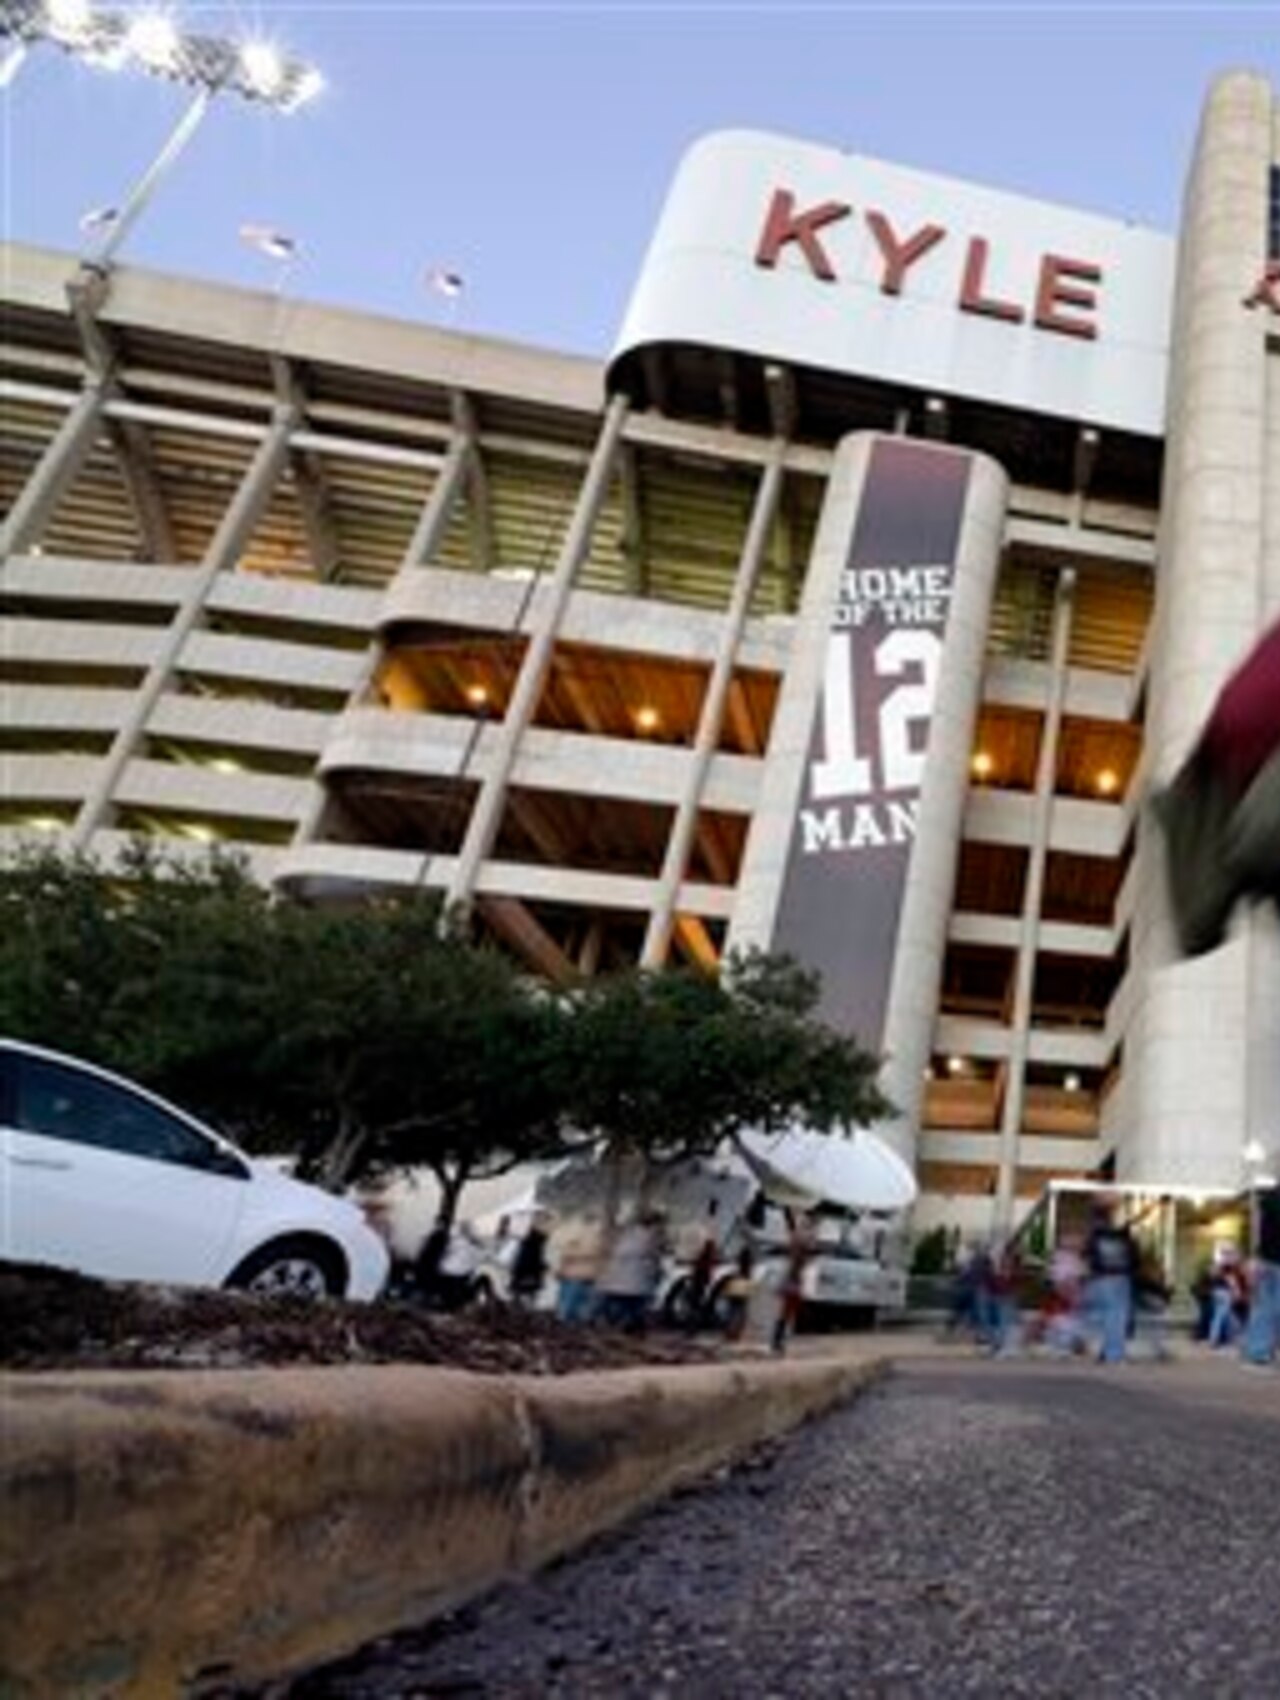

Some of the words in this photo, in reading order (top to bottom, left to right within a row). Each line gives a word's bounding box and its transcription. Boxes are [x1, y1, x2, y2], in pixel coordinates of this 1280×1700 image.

[754, 187, 1102, 341] KYLE
[882, 598, 948, 624] THE
[811, 627, 944, 800] 12
